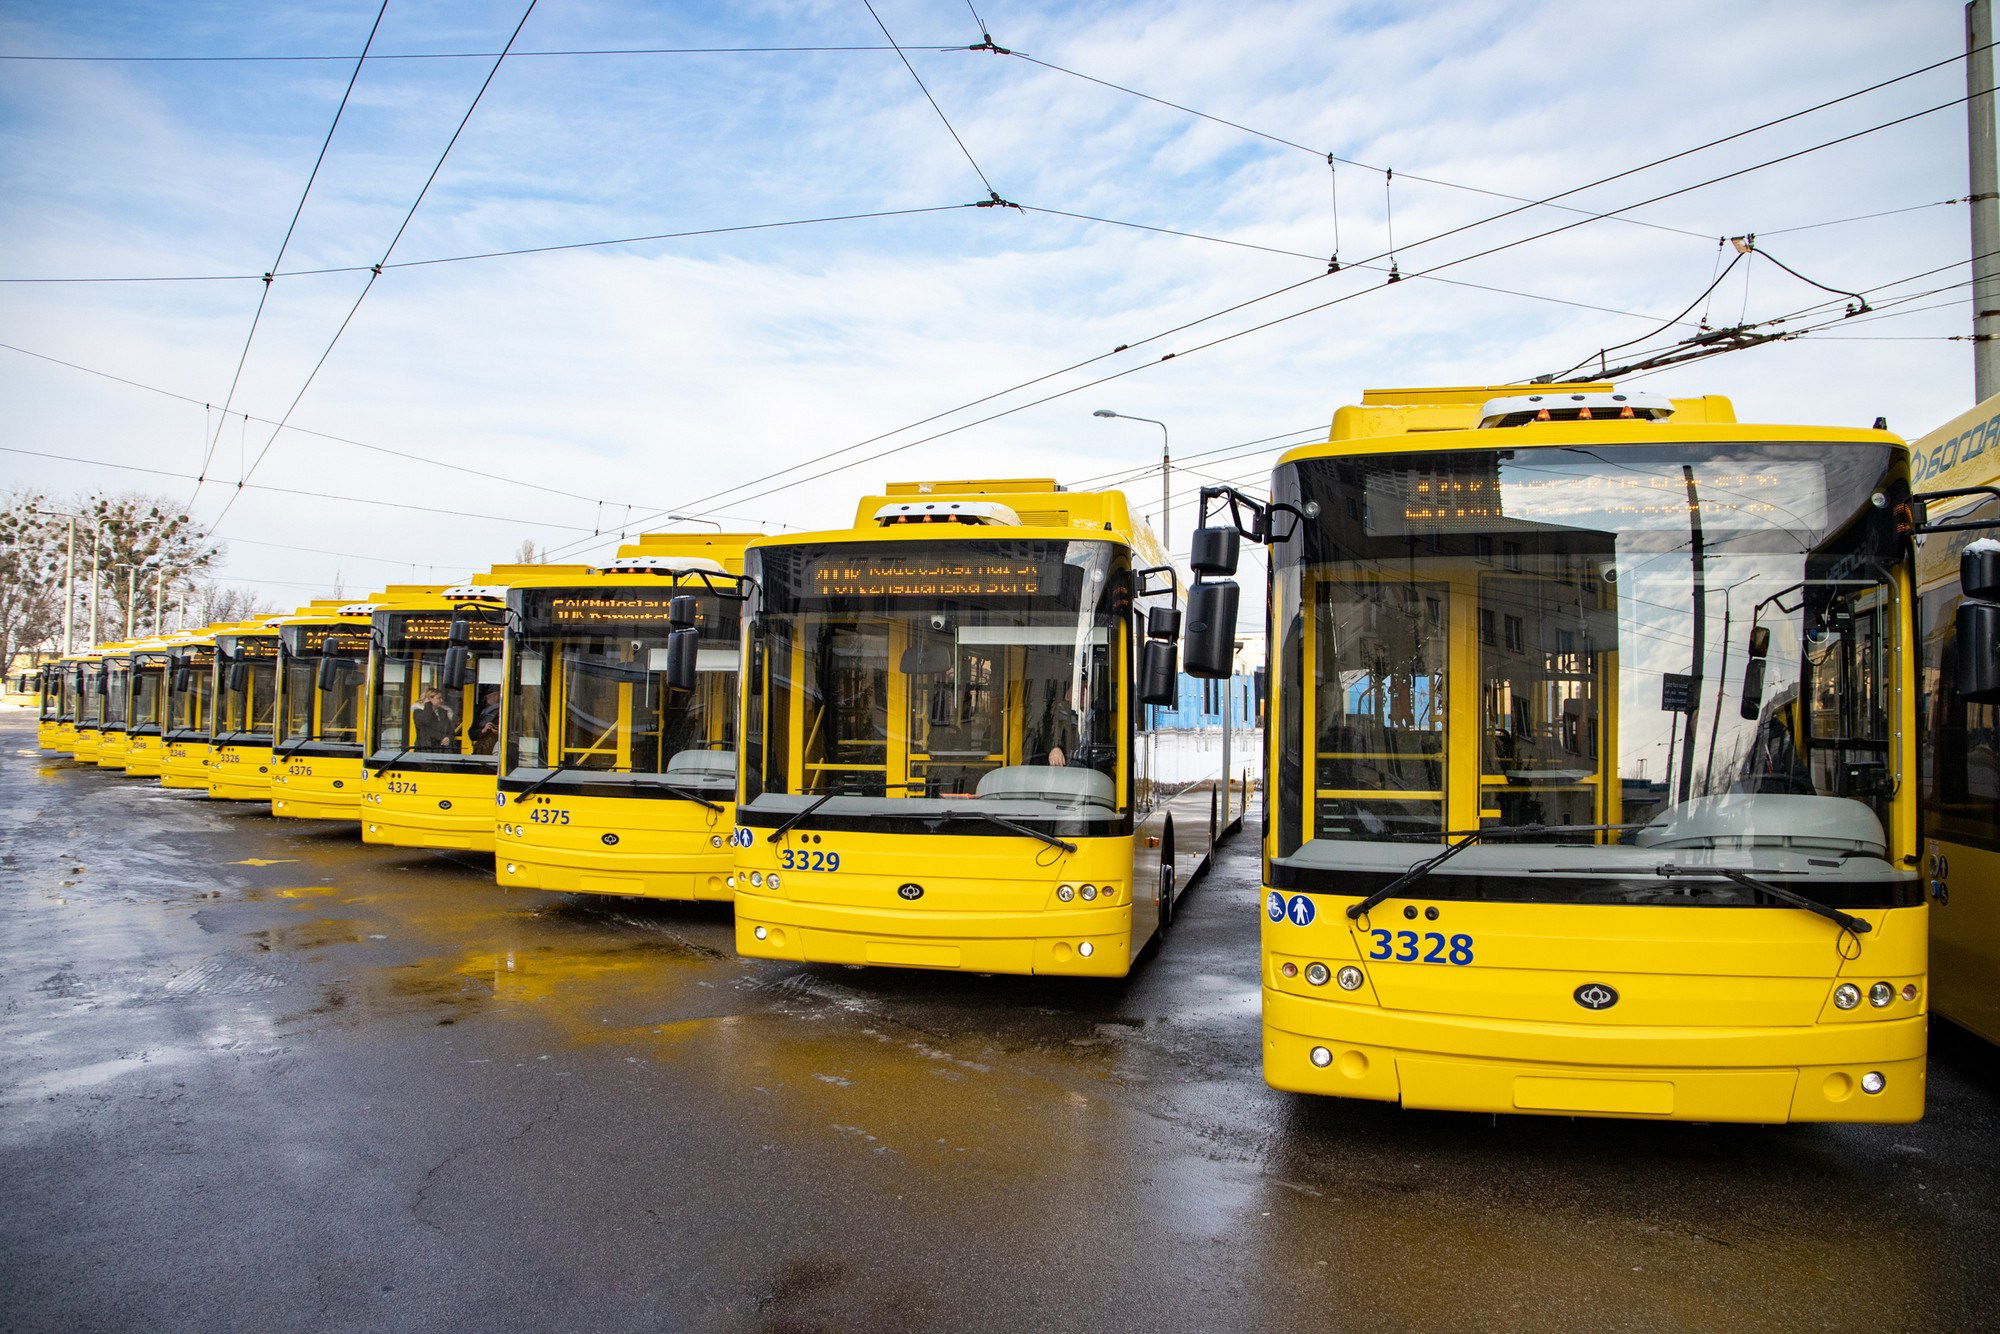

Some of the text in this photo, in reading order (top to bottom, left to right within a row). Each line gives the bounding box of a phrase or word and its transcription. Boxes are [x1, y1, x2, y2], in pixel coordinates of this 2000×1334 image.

[1925, 414, 2000, 480] БОГДА
[221, 754, 240, 763] 3326
[288, 765, 312, 776] 4376
[388, 782, 417, 794] 4374
[531, 809, 570, 825] 4375
[782, 849, 840, 872] 3329
[1369, 929, 1474, 966] 3328
